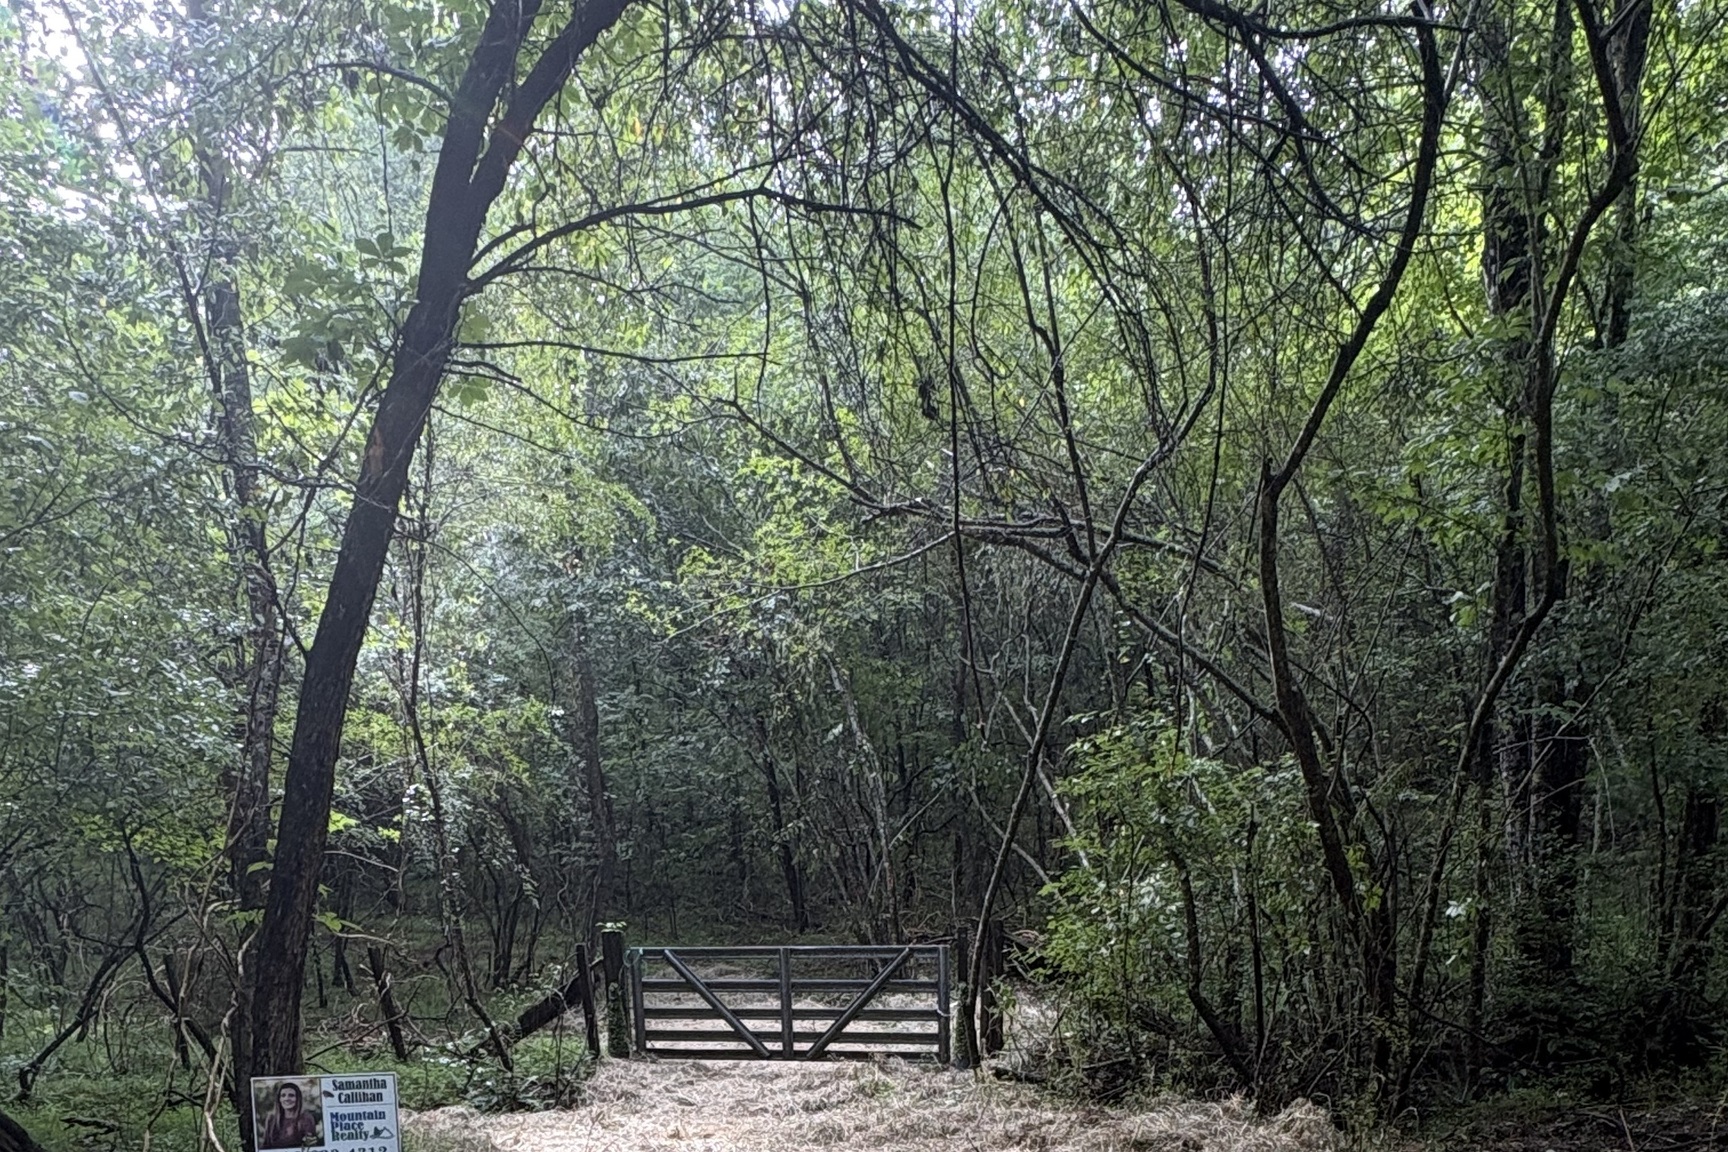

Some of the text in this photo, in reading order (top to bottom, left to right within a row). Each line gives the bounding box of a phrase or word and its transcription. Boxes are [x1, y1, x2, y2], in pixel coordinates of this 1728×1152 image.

[332, 1078, 387, 1091] Samantha
[338, 1091, 384, 1104] Callihan
[330, 1110, 386, 1122] Mountain
[331, 1121, 365, 1132] Place
[331, 1130, 370, 1142] Realty
